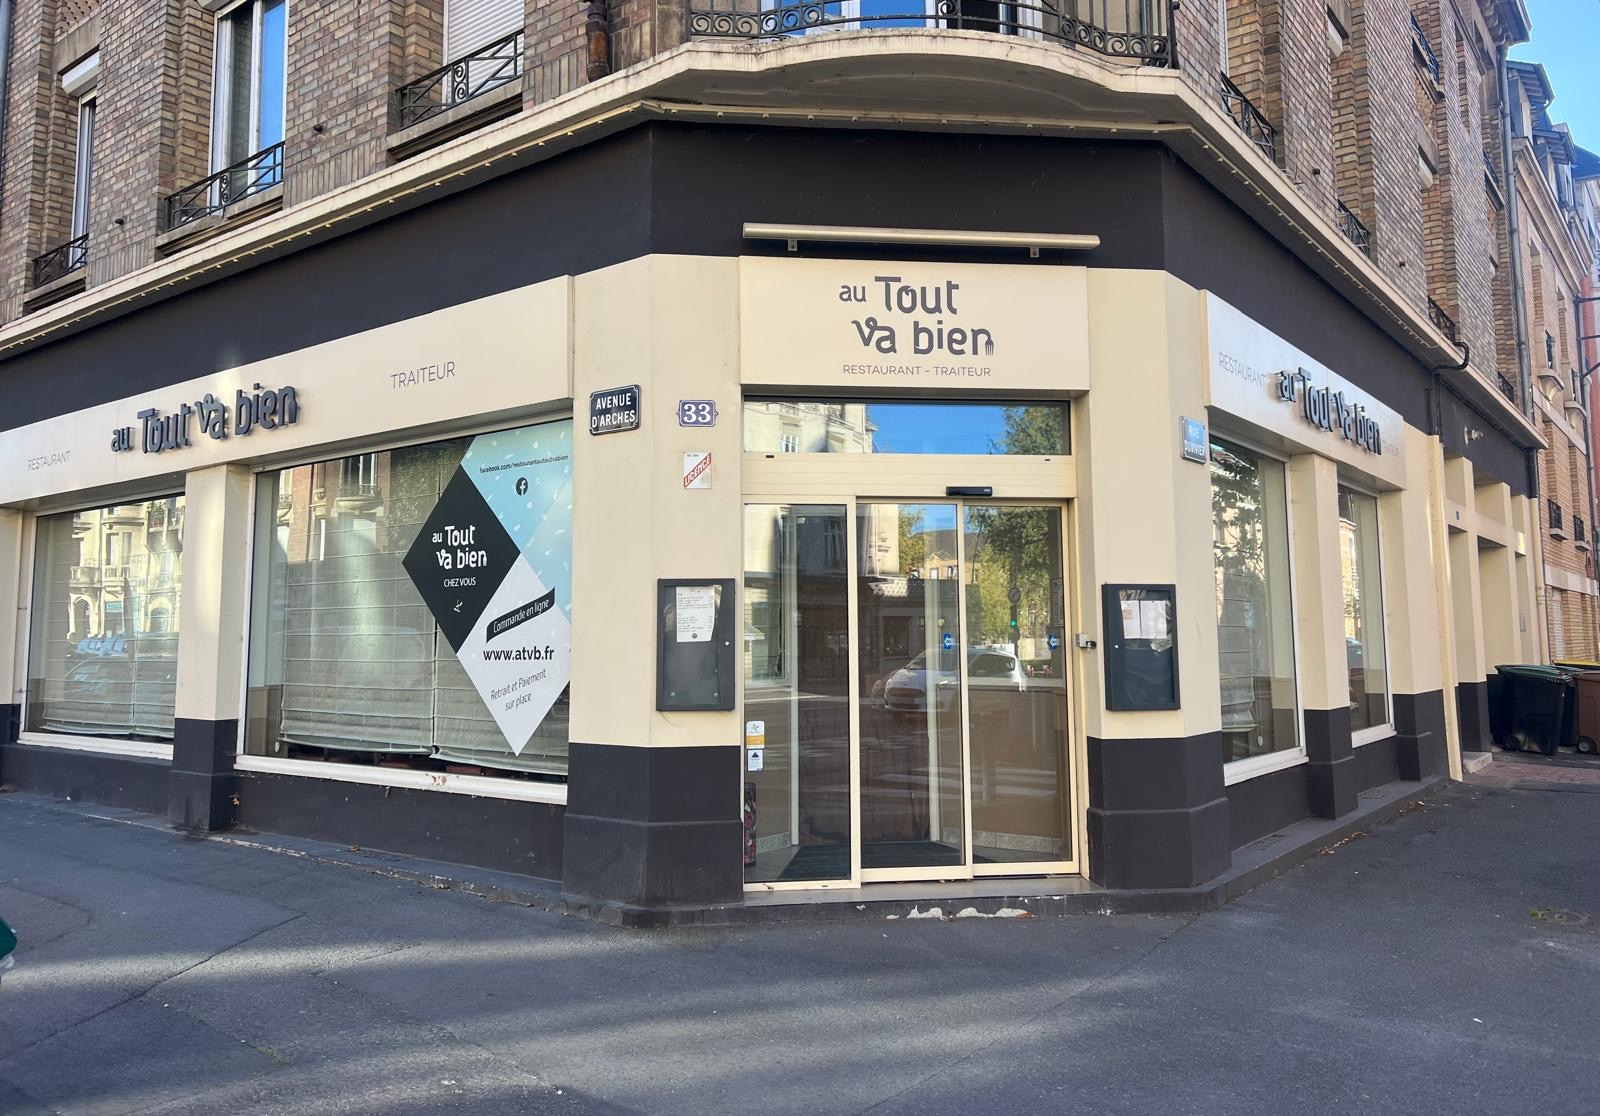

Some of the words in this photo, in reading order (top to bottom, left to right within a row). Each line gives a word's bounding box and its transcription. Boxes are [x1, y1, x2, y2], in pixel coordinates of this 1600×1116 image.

[838, 284, 867, 302] au
[874, 276, 960, 315] Tout
[913, 319, 995, 356] bien
[389, 361, 456, 390] TRAITEUR
[843, 364, 922, 376] RESTAURANT
[934, 366, 992, 377] TRAITEUR
[1217, 351, 1267, 389] RESTAURANT
[595, 392, 632, 411] AVENUE
[683, 403, 712, 423] 33
[1280, 371, 1296, 402] au
[1298, 366, 1334, 432] Tout
[1354, 402, 1382, 455] bien
[111, 427, 134, 453] au
[137, 402, 193, 455] Tout
[235, 382, 298, 436] bien
[591, 409, 636, 429] D'ARCHES
[27, 450, 72, 471] RESTAURANT
[683, 453, 712, 488] LICENCE
[432, 532, 443, 543] au
[444, 524, 476, 547] Tout
[456, 547, 488, 569] bien
[443, 578, 460, 588] CHEZ
[460, 576, 477, 587] VOUS
[493, 611, 526, 633] Commande
[526, 606, 534, 617] en
[534, 598, 550, 615] ligne
[482, 645, 555, 661] www.atvb.fr
[490, 686, 511, 701] Retrait
[511, 681, 518, 691] et
[518, 668, 547, 689] Paiement
[505, 699, 516, 711] sur
[515, 692, 532, 710] place
